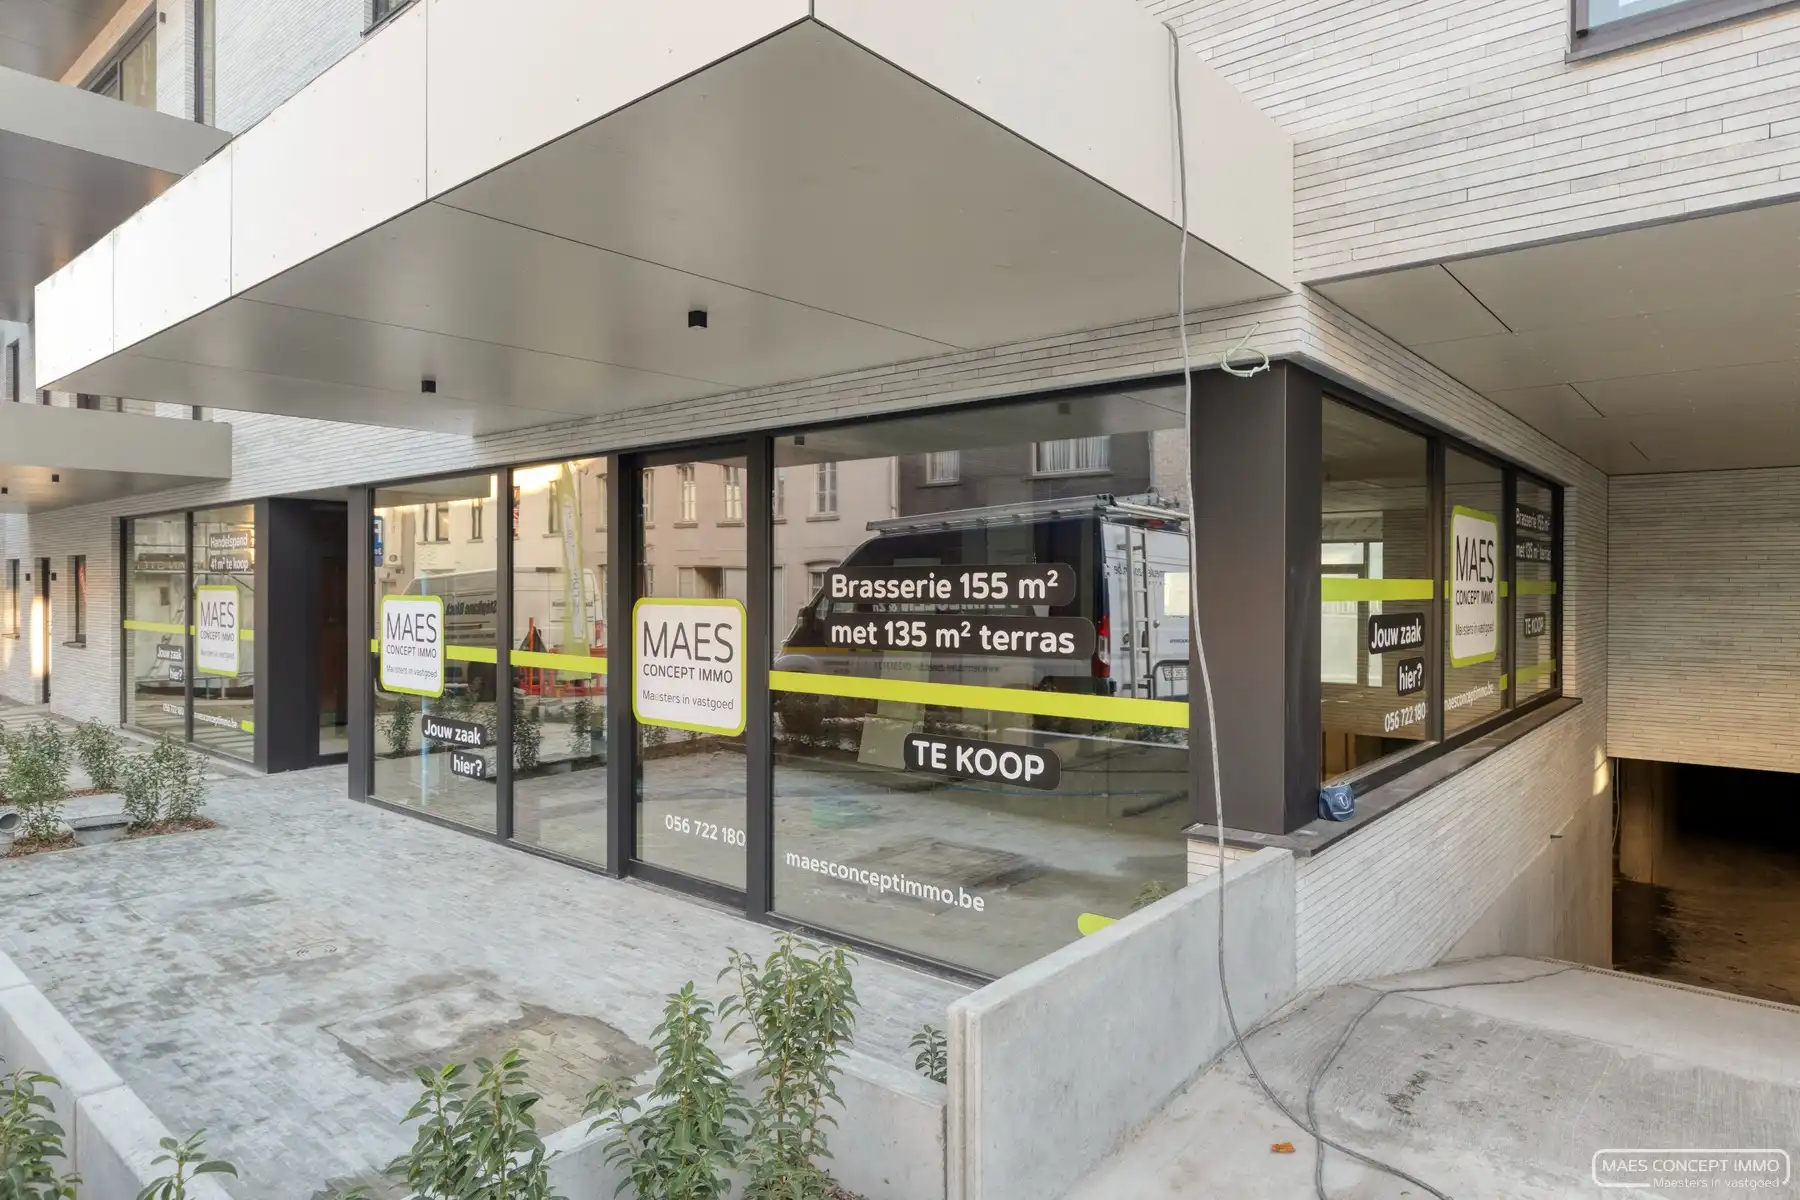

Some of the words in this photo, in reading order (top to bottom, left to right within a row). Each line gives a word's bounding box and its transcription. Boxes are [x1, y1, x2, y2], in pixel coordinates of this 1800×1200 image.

[210, 533, 248, 549] Handelspand
[226, 558, 233, 570] te
[233, 557, 248, 572] koop
[1456, 535, 1495, 584] MAES
[832, 572, 952, 599] Brasserie
[960, 572, 1008, 600] 155
[1018, 570, 1058, 600] m²
[1456, 590, 1480, 606] CONCEPT
[1481, 590, 1494, 605] IMMO
[200, 602, 234, 628] MAES
[387, 612, 437, 643] MAES
[200, 630, 219, 640] CONCEPT
[222, 631, 234, 642] IMMO
[644, 620, 734, 664] MAES
[831, 622, 878, 646] met
[884, 620, 927, 648] 135
[936, 621, 971, 648] m²
[979, 624, 1076, 654] terras
[1371, 622, 1398, 648] Jouw
[1400, 618, 1422, 644] zaak
[387, 644, 416, 659] CONCEPT
[418, 647, 437, 659] IMMO
[408, 669, 413, 677] in
[414, 668, 438, 680] vastgoed
[643, 664, 694, 680] CONCEPT
[699, 668, 733, 684] IMMO
[1399, 662, 1423, 692] hier?
[682, 694, 690, 704] in
[692, 698, 734, 712] vastgoed
[1384, 712, 1400, 732] 056
[1401, 706, 1414, 726] 722
[1414, 702, 1426, 722] 180
[424, 720, 452, 740] Jouw
[455, 727, 480, 744] zaak
[454, 754, 482, 776] hier?
[912, 740, 947, 770] TE
[956, 745, 1045, 782] KOOP
[665, 814, 690, 834] 056
[694, 821, 718, 842] 722
[722, 826, 746, 847] 180
[786, 851, 985, 912] maesconceptimmo.be
